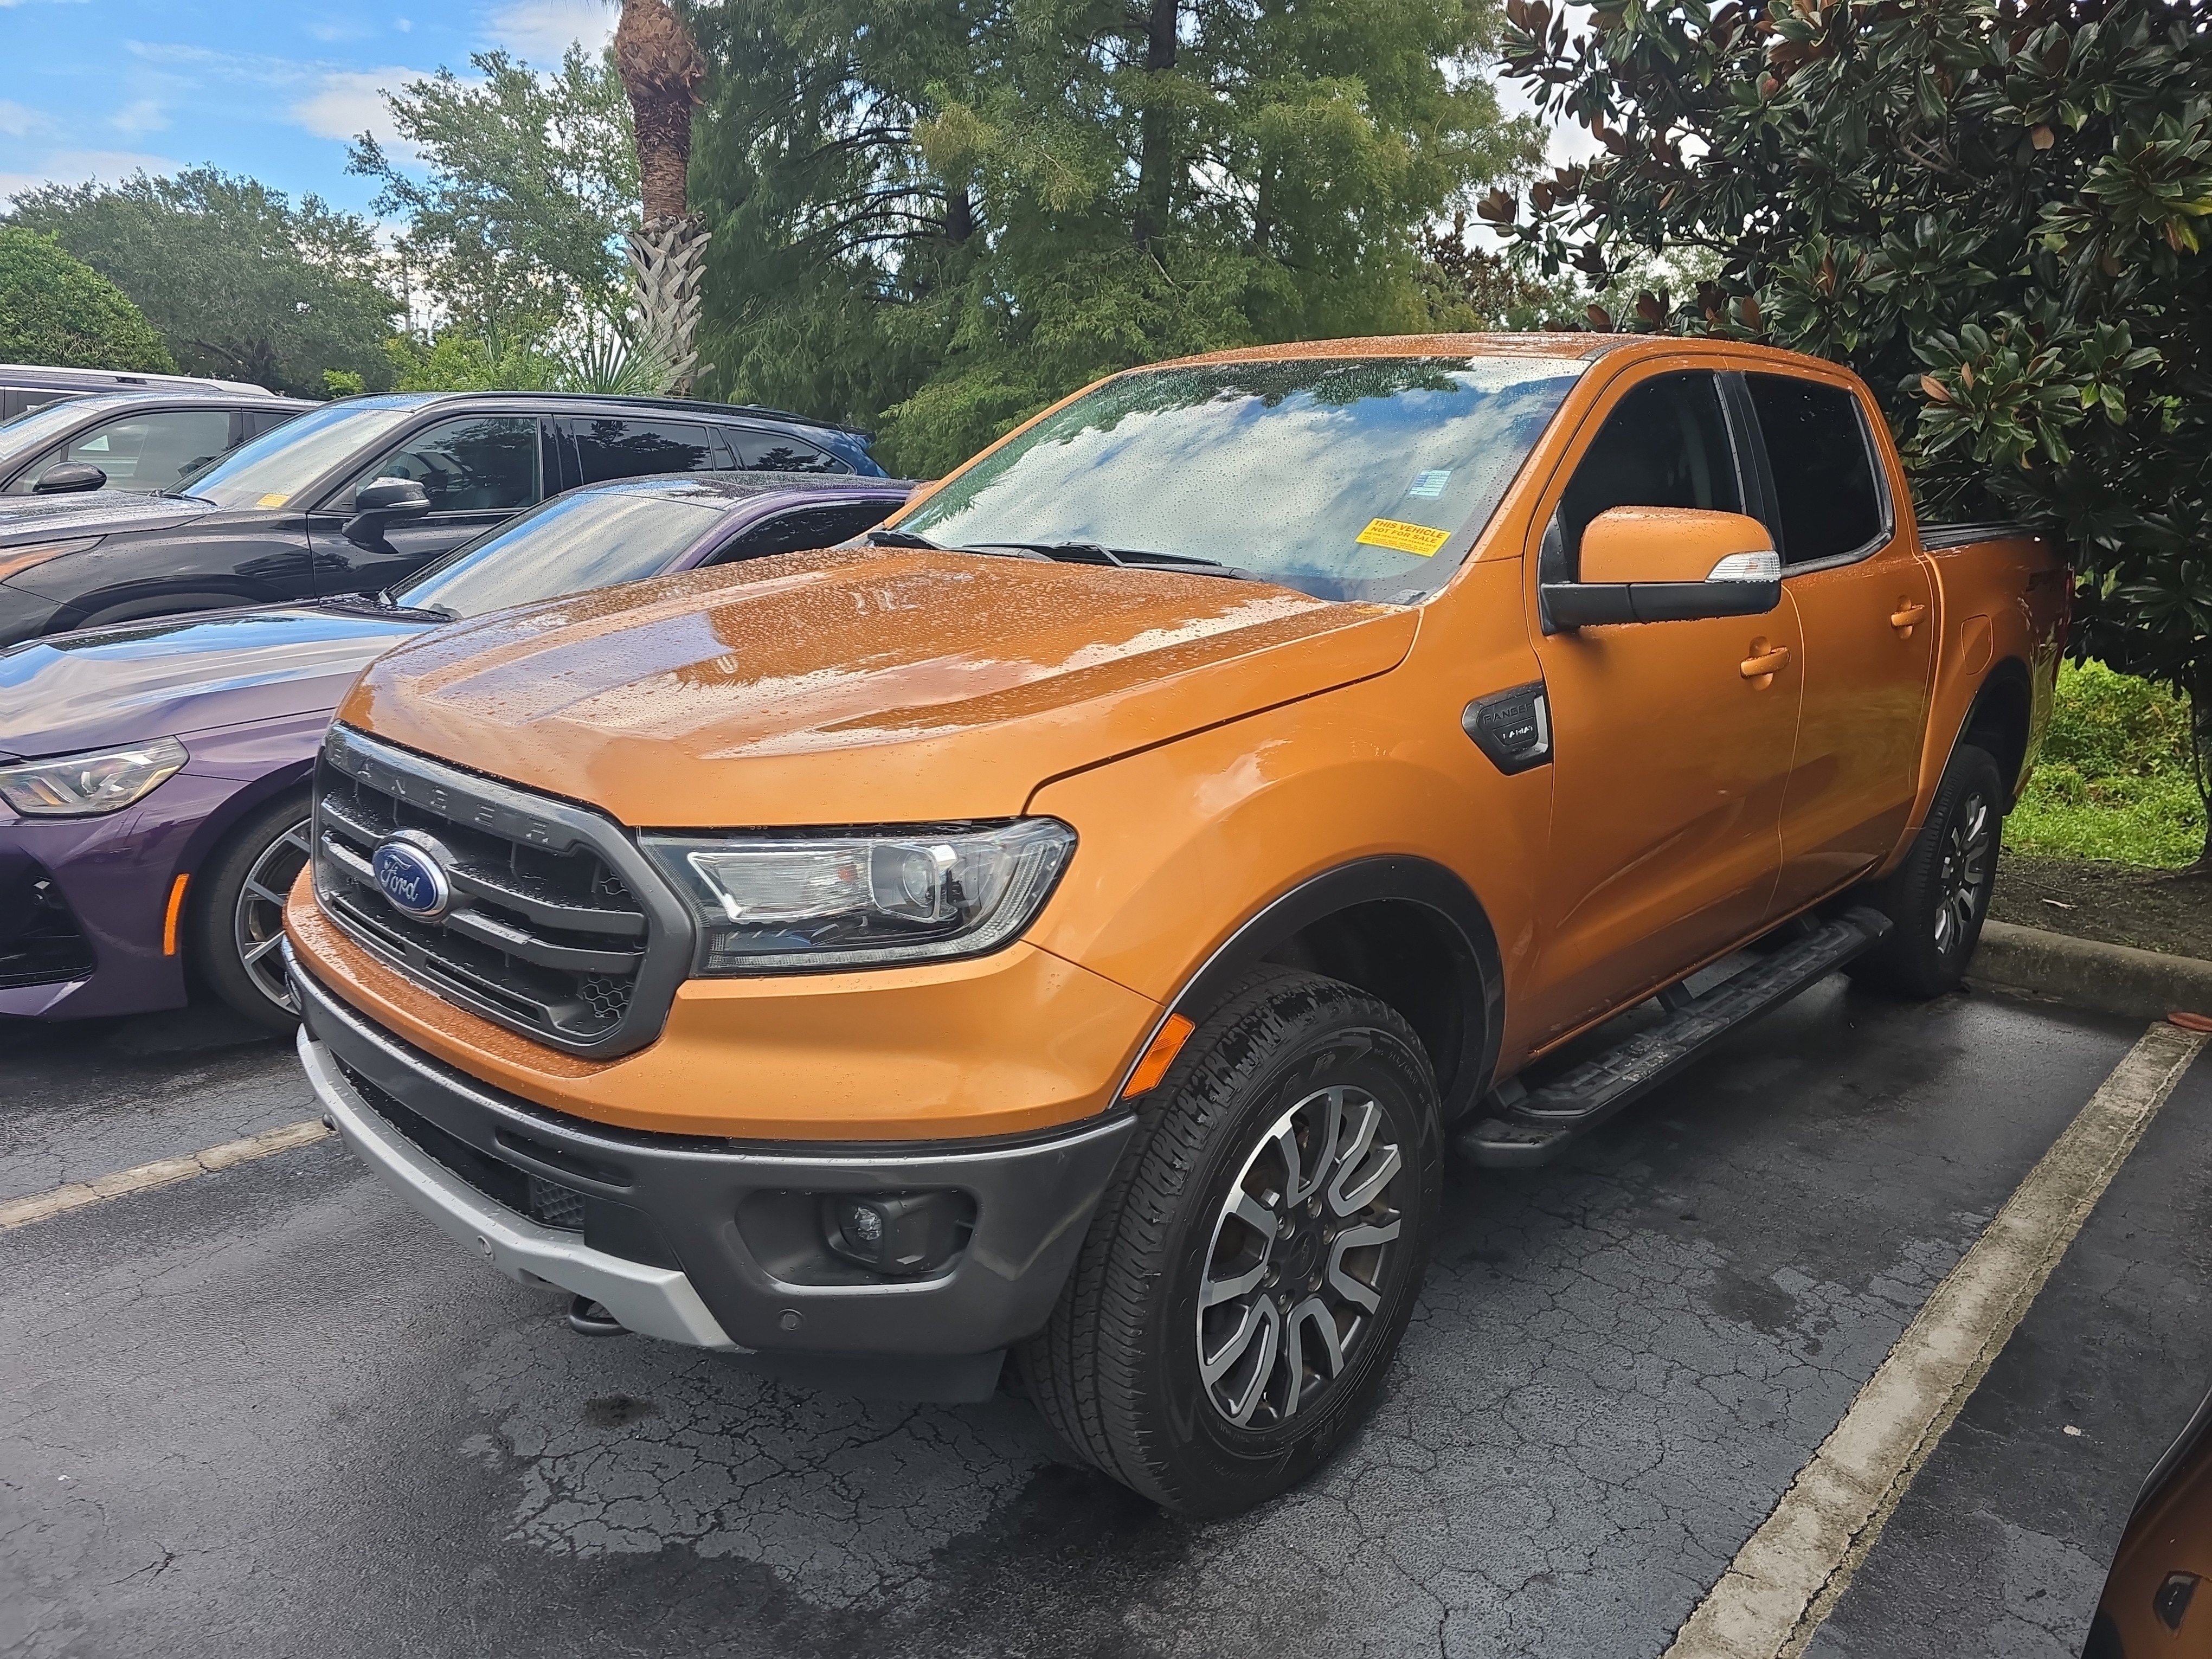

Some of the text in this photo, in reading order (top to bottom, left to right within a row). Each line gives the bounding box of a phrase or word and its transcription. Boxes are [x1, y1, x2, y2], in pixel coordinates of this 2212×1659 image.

[1375, 520, 1445, 538] THIS VEHICLE
[1412, 534, 1437, 543] SALE
[1483, 703, 1534, 724] RANGER
[381, 854, 421, 902] Ford
